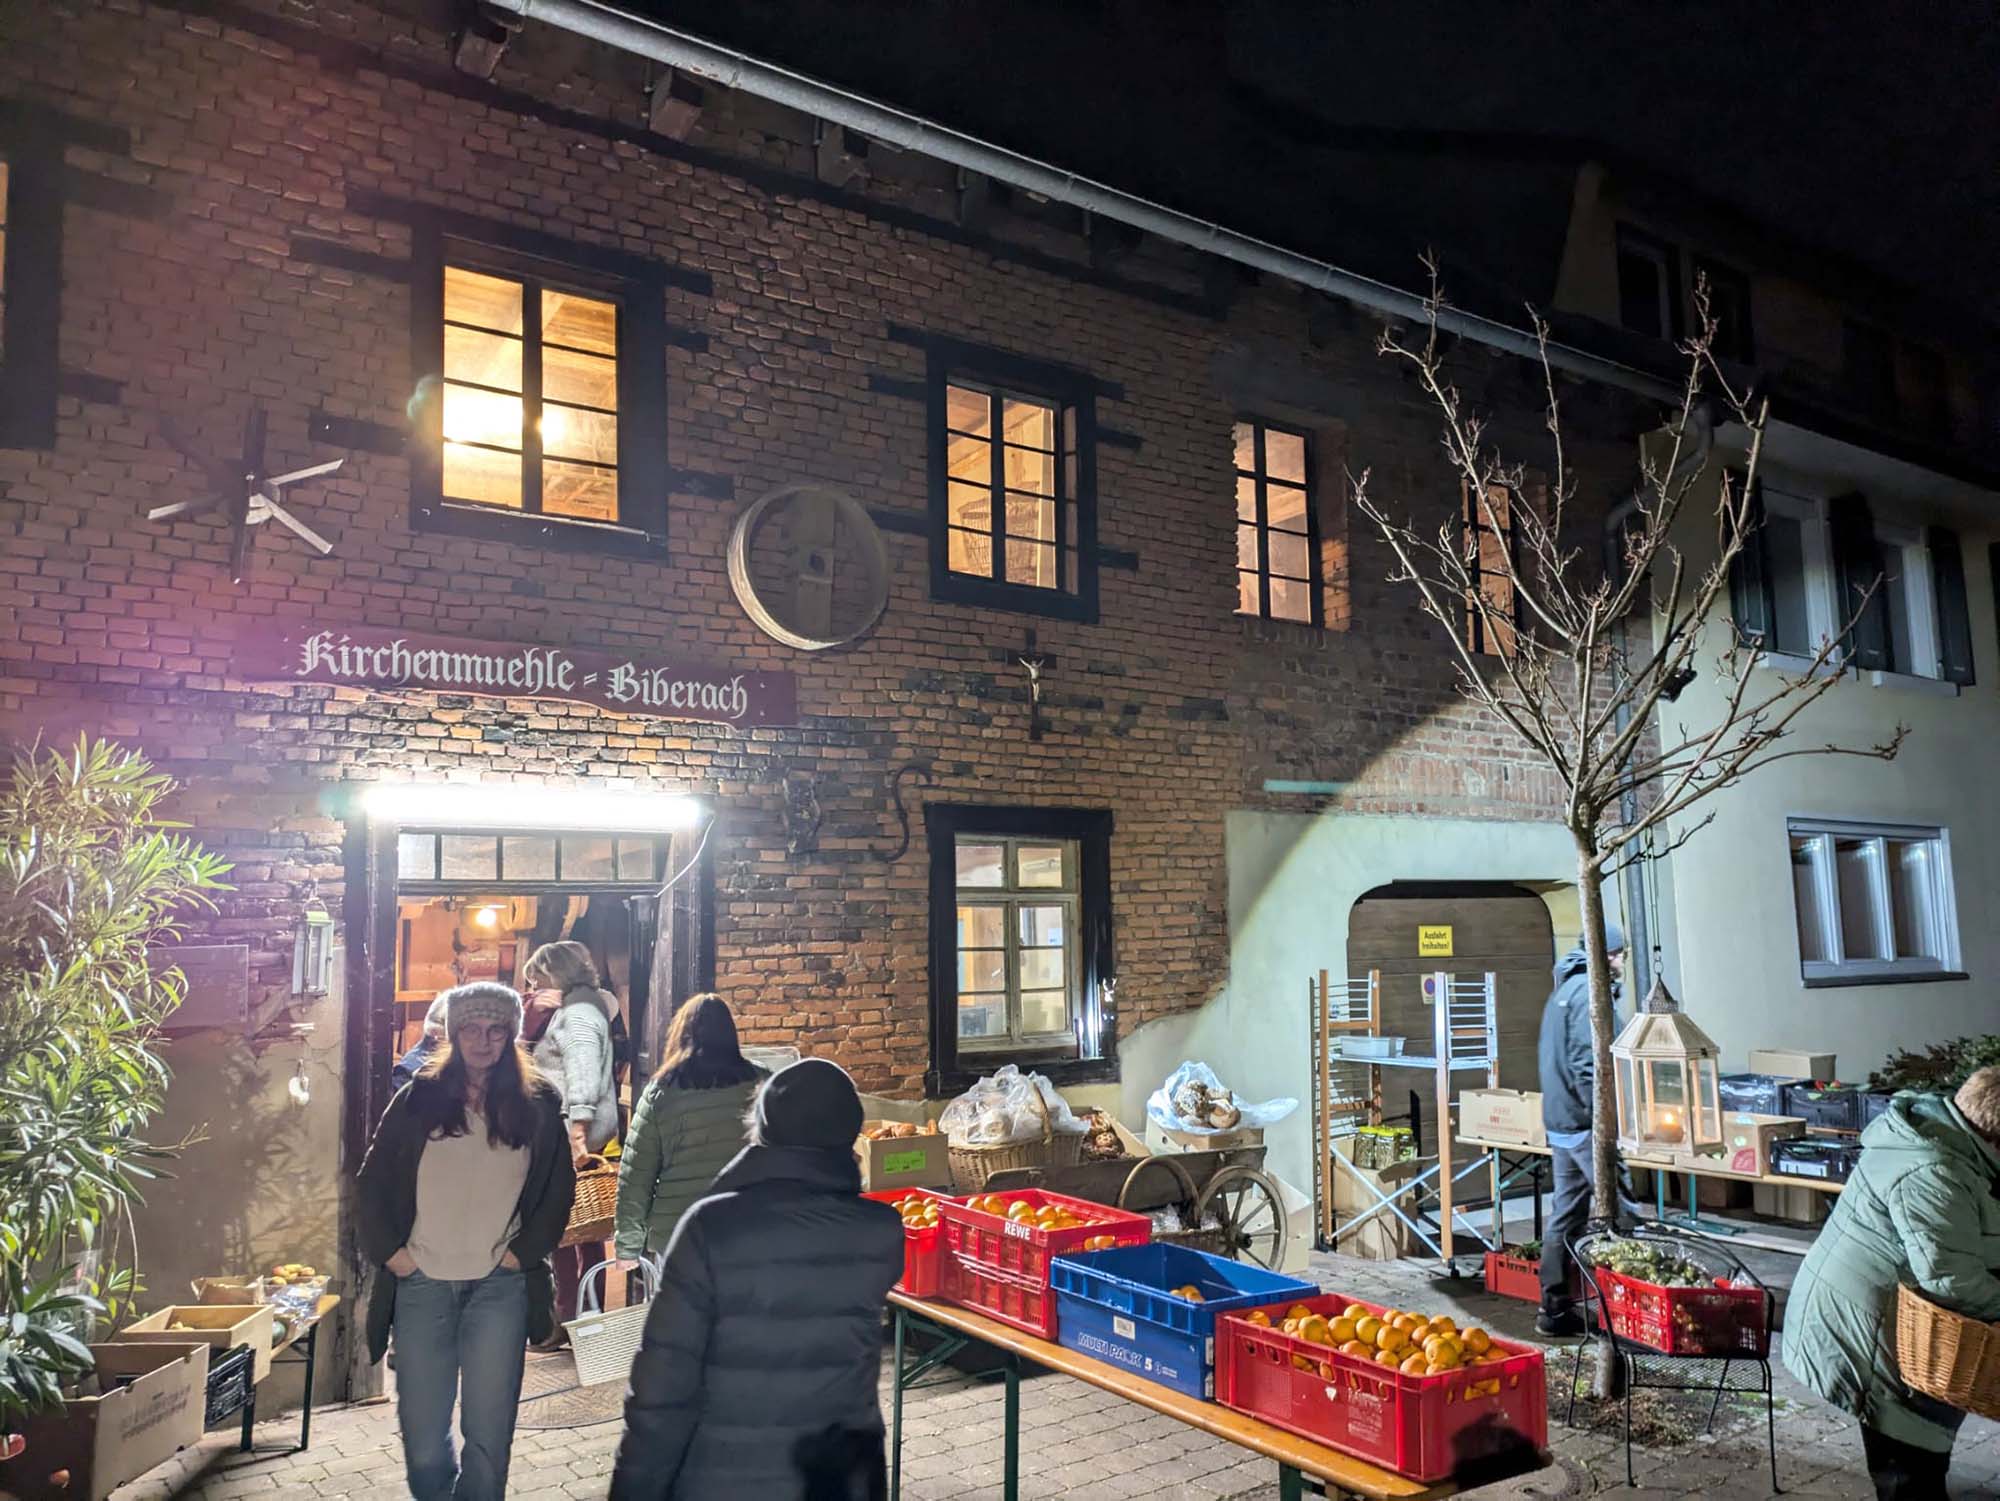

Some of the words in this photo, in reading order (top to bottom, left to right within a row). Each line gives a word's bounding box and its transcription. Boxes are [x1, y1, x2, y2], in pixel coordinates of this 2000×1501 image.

[296, 631, 575, 696] Kirchenmuehle
[605, 662, 748, 720] Biberach
[1004, 1222, 1031, 1241] REWE
[1078, 1333, 1108, 1355] MULTI
[1109, 1344, 1143, 1367] PACK
[1145, 1357, 1153, 1371] 5
